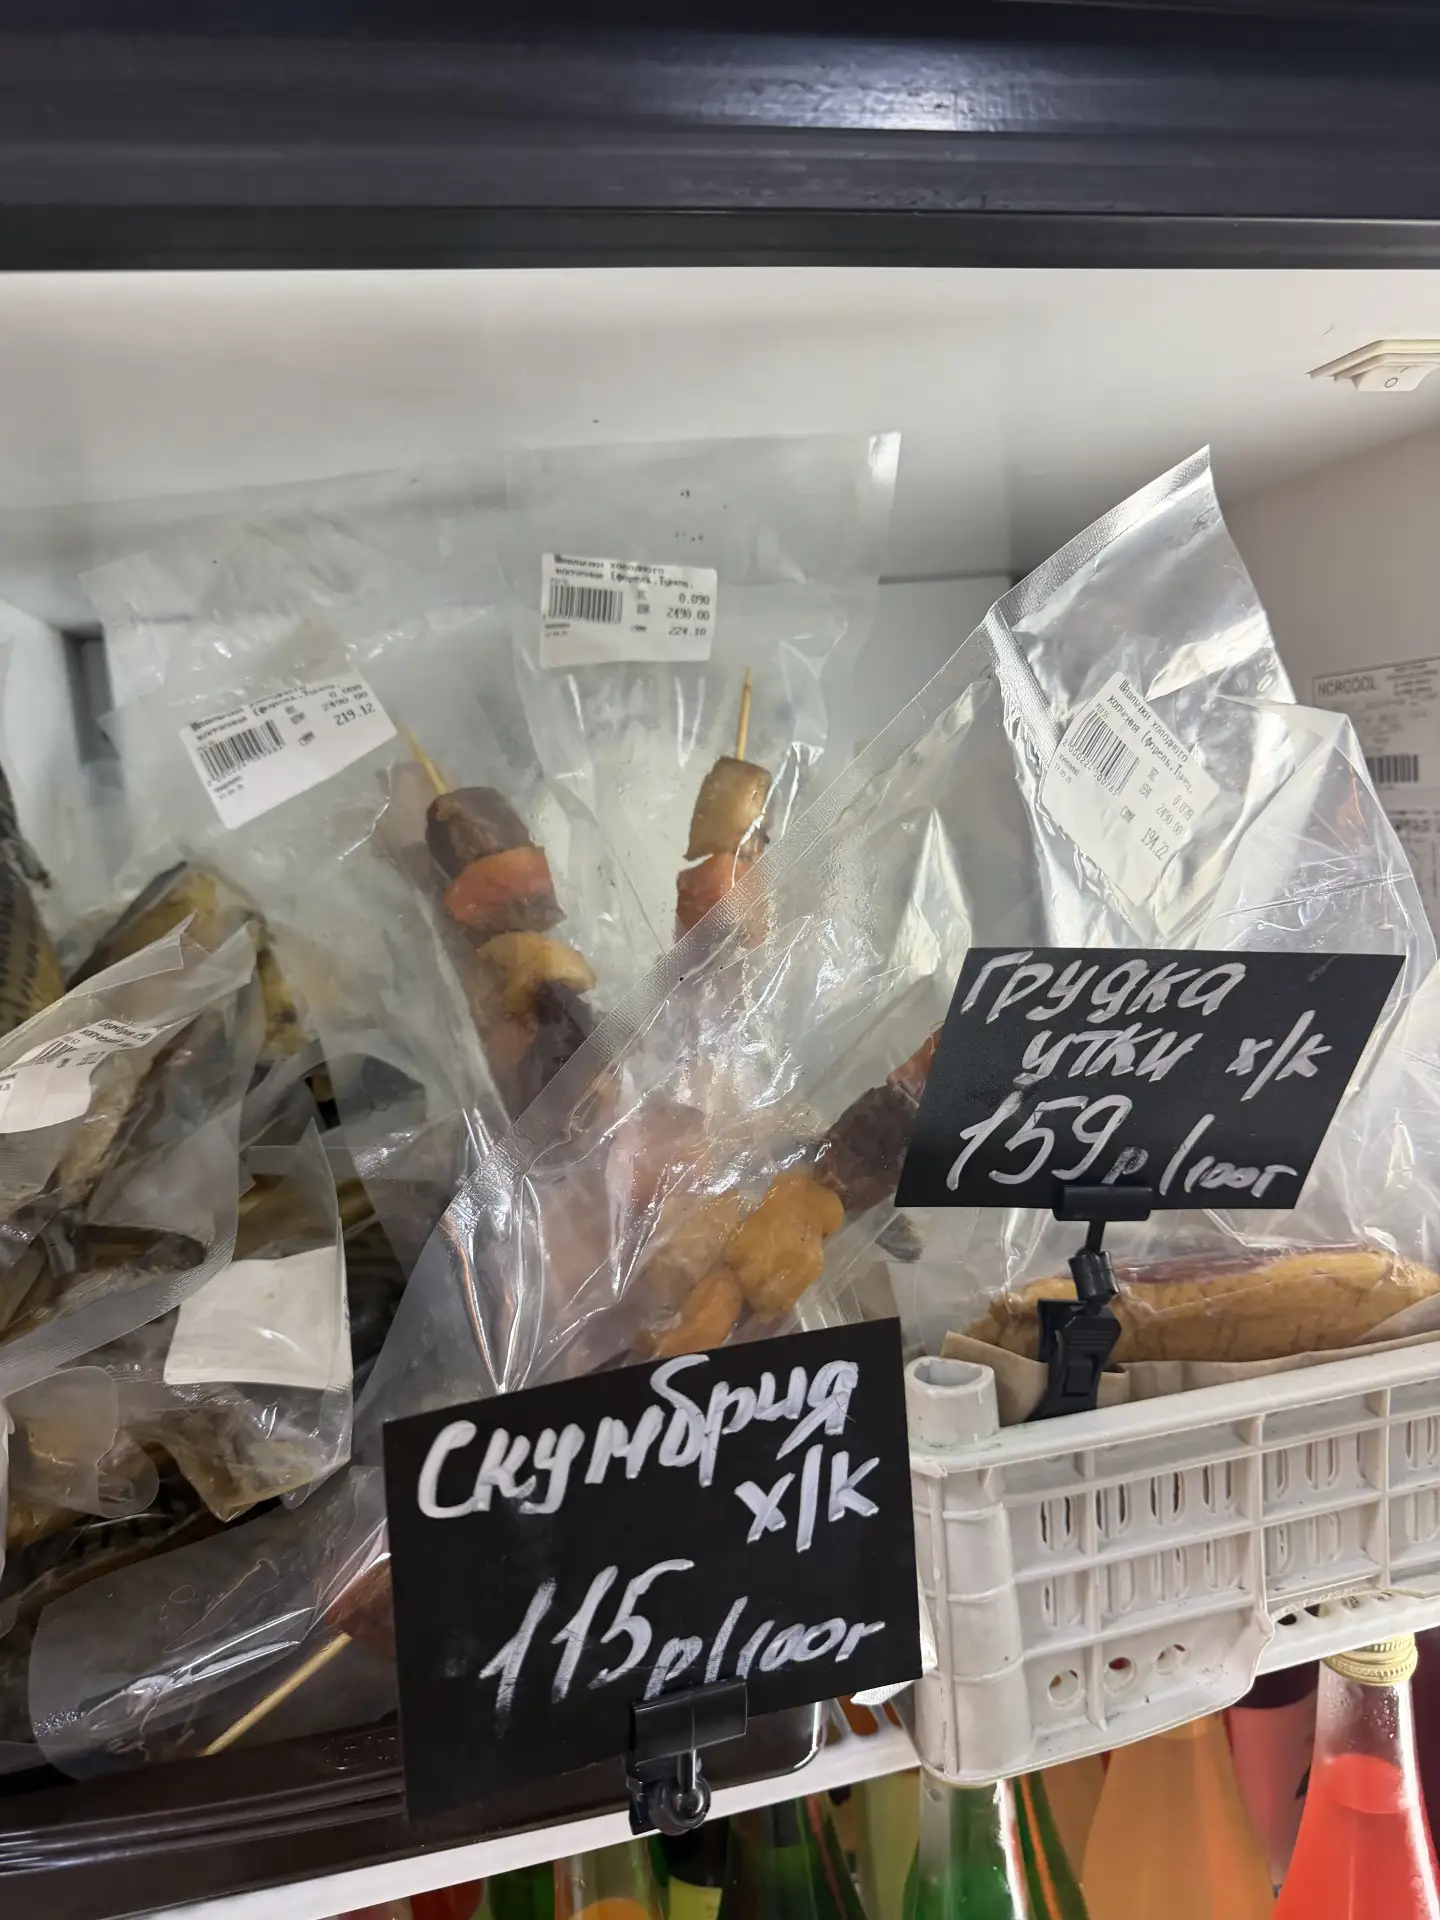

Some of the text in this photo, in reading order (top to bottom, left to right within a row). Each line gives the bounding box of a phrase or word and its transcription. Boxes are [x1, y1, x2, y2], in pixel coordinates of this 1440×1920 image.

[666, 607, 710, 621] 2490.00
[335, 702, 377, 726] 219.12
[1107, 695, 1140, 733] копчения
[1118, 679, 1189, 763] Шашлычки холодного
[1155, 803, 1184, 836] 2490.00
[1141, 827, 1169, 861] 194.22
[960, 950, 1247, 1024] Грудка
[417, 1353, 858, 1519] Скумбрия
